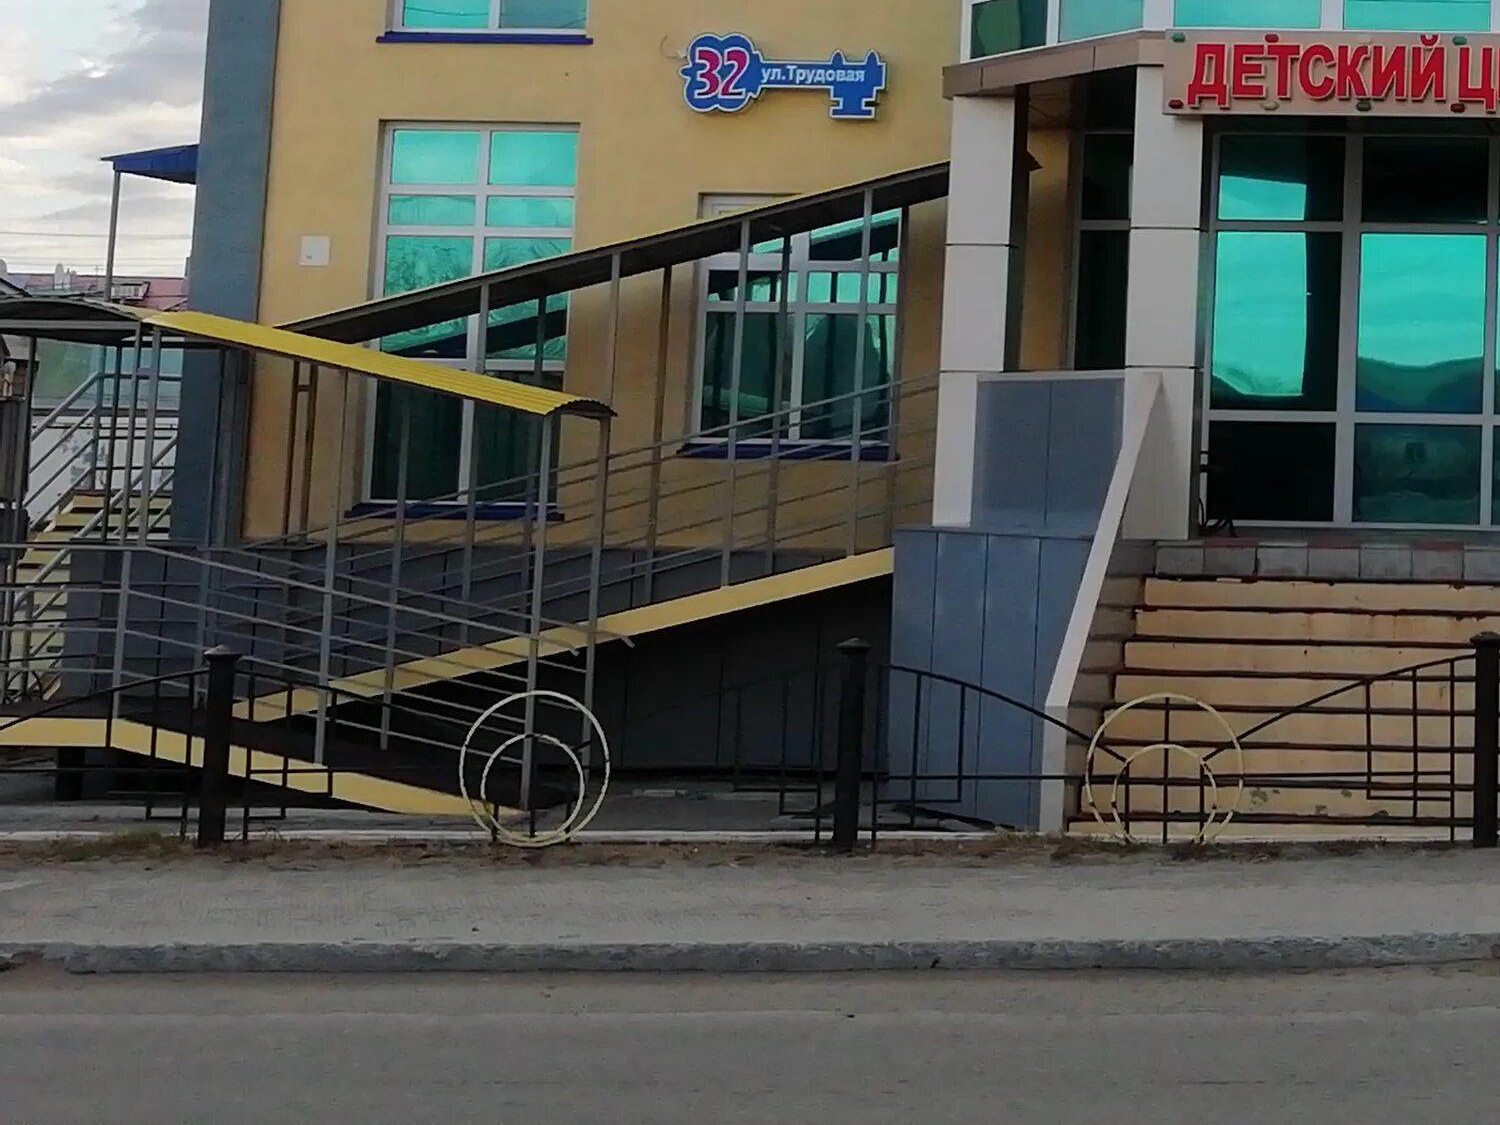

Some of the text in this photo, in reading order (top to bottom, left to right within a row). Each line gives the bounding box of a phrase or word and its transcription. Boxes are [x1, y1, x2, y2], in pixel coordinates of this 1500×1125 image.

[693, 46, 866, 100] 32 ул.Трудовая
[1187, 33, 1447, 108] ДЕТСКИЙ
